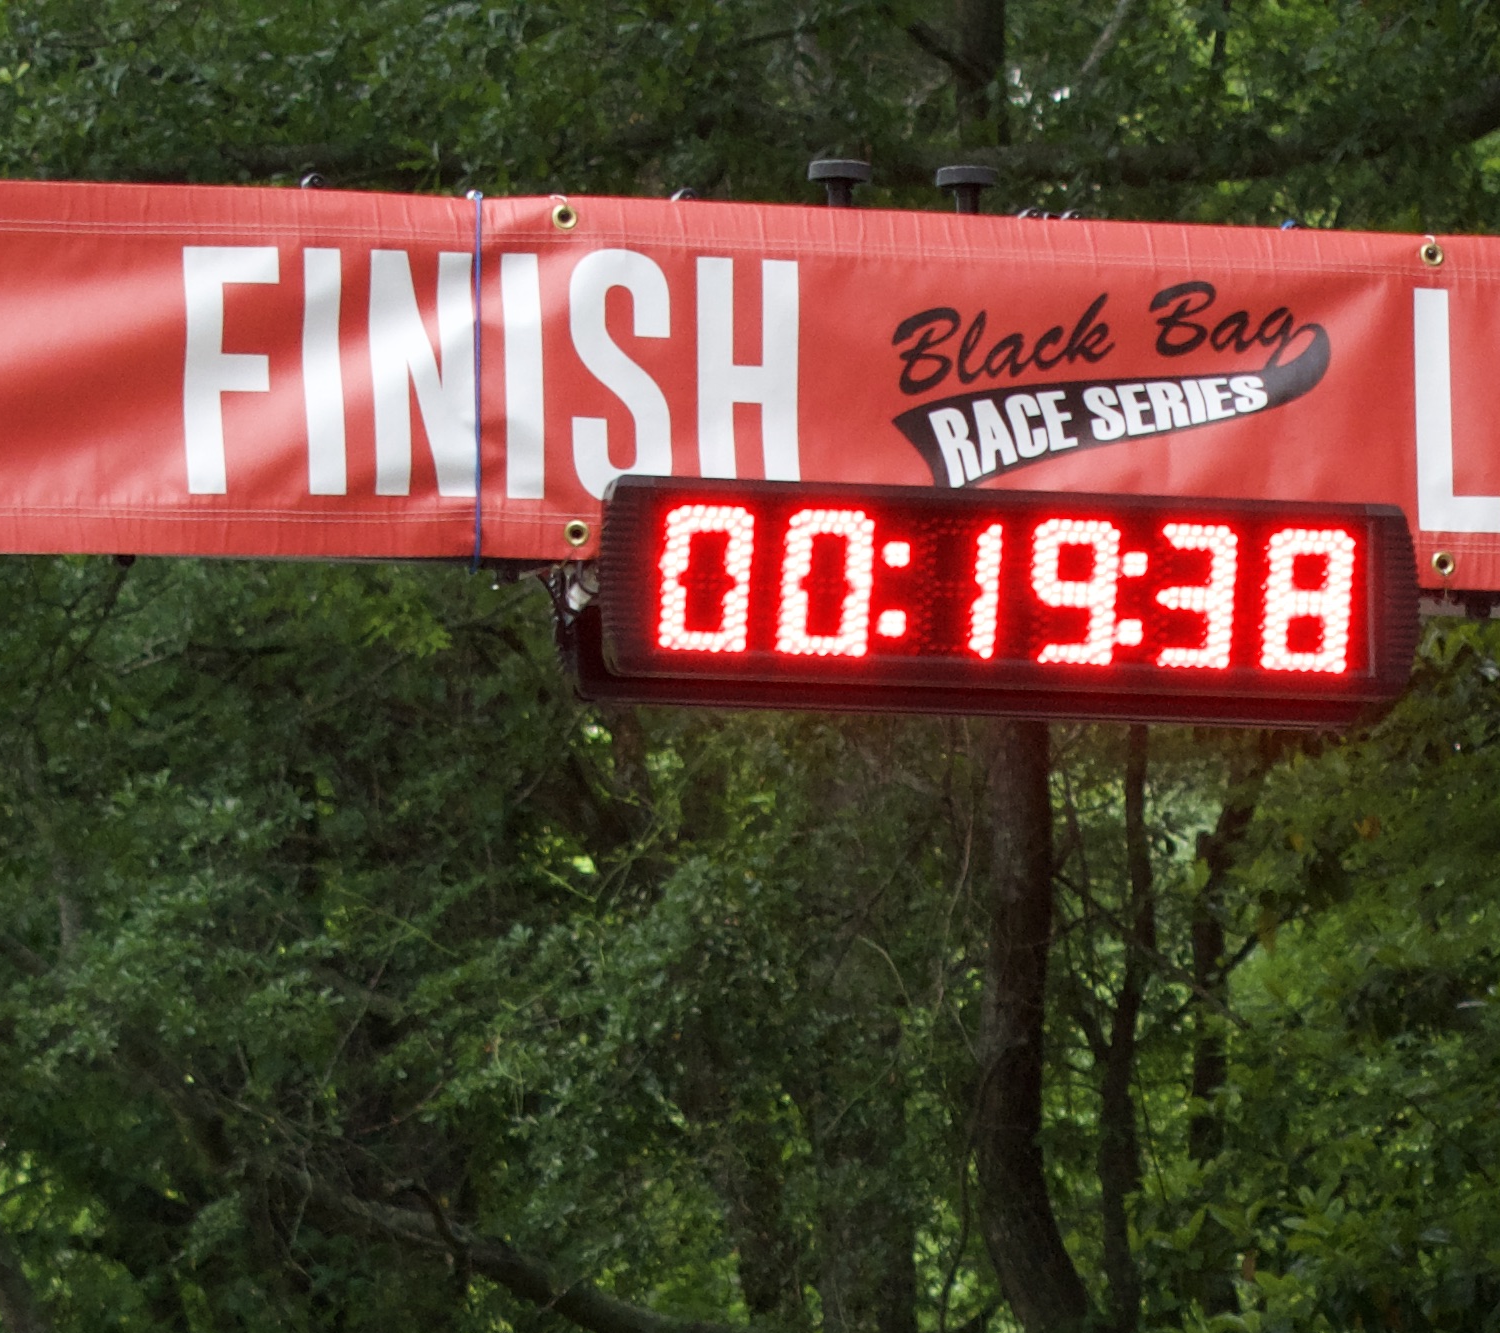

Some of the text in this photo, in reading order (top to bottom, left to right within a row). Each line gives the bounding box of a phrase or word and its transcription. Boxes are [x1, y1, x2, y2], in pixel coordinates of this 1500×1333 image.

[183, 246, 801, 501] FINISH
[892, 281, 1297, 395] Black Bag
[929, 376, 1268, 488] RACE SERIES
[657, 504, 1357, 674] 00:19:38
